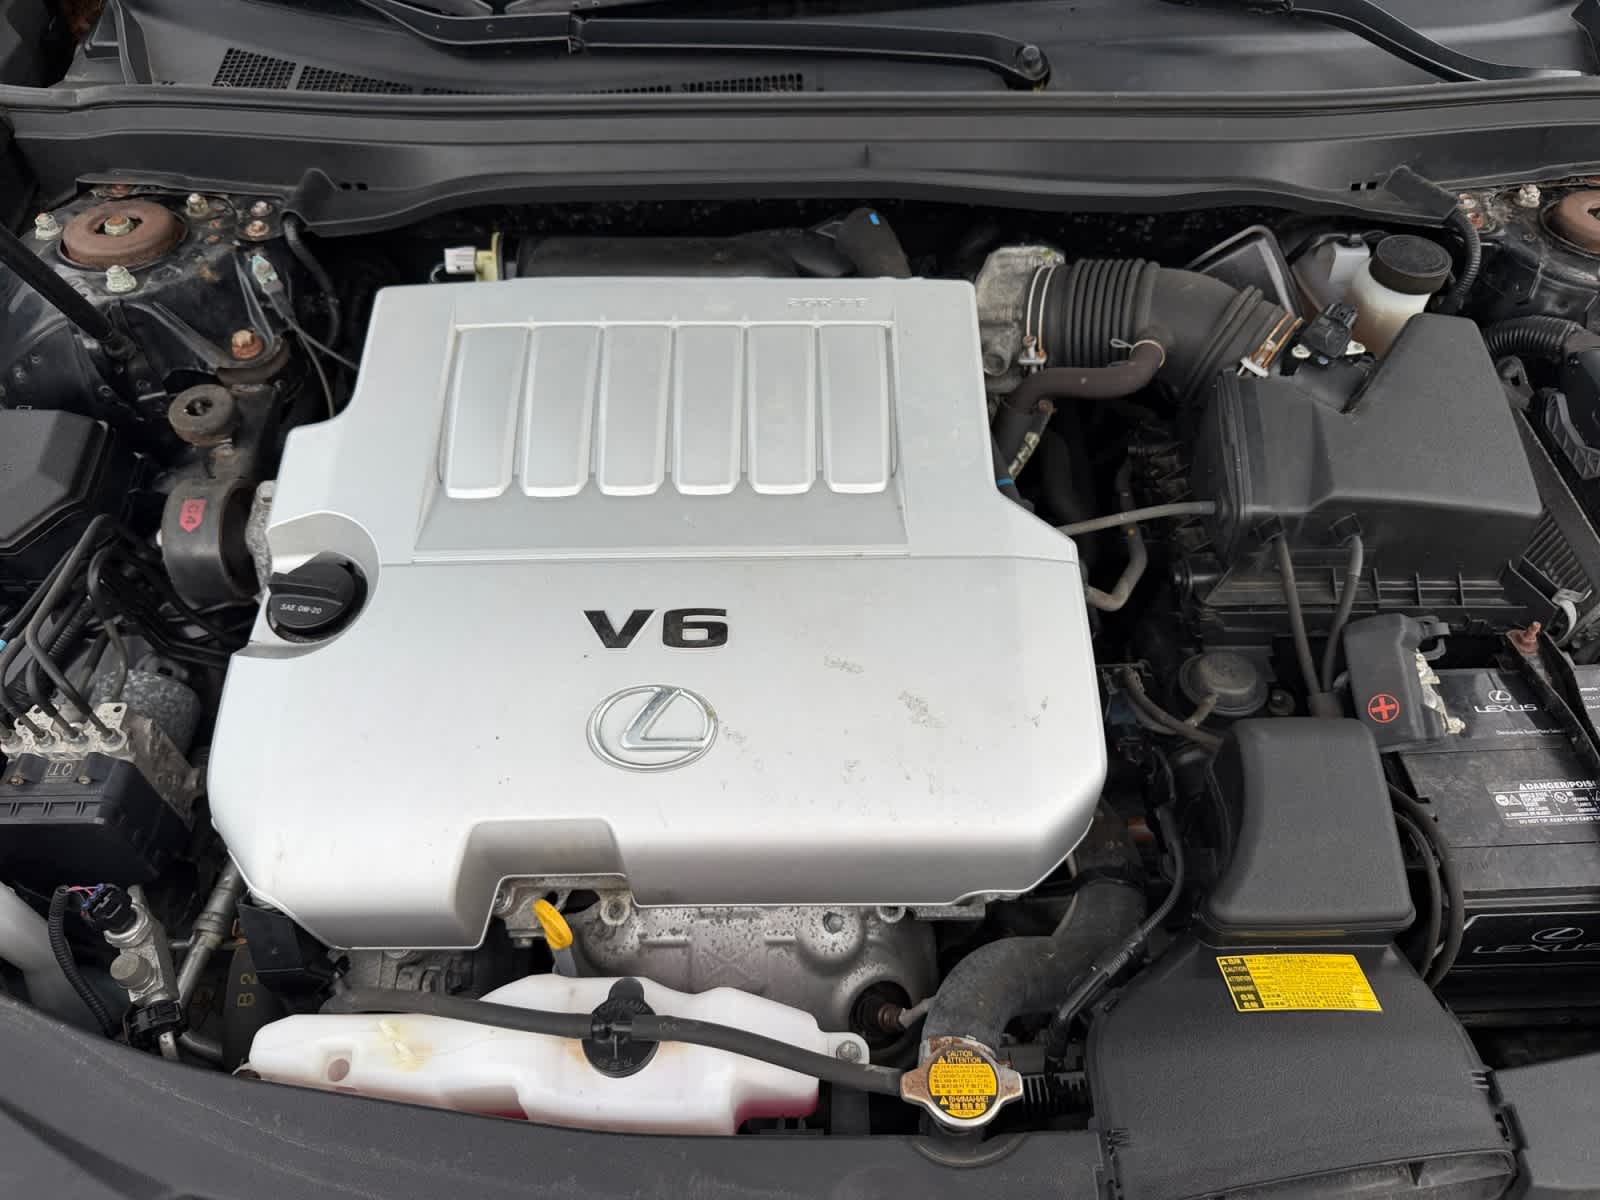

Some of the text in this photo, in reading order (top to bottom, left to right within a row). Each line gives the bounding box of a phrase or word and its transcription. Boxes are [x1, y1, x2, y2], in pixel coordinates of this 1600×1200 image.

[280, 603, 322, 614] SAE 0W-20
[583, 607, 729, 649] V6
[1474, 703, 1537, 713] LEXUS
[947, 1056, 982, 1064] ATTENTION
